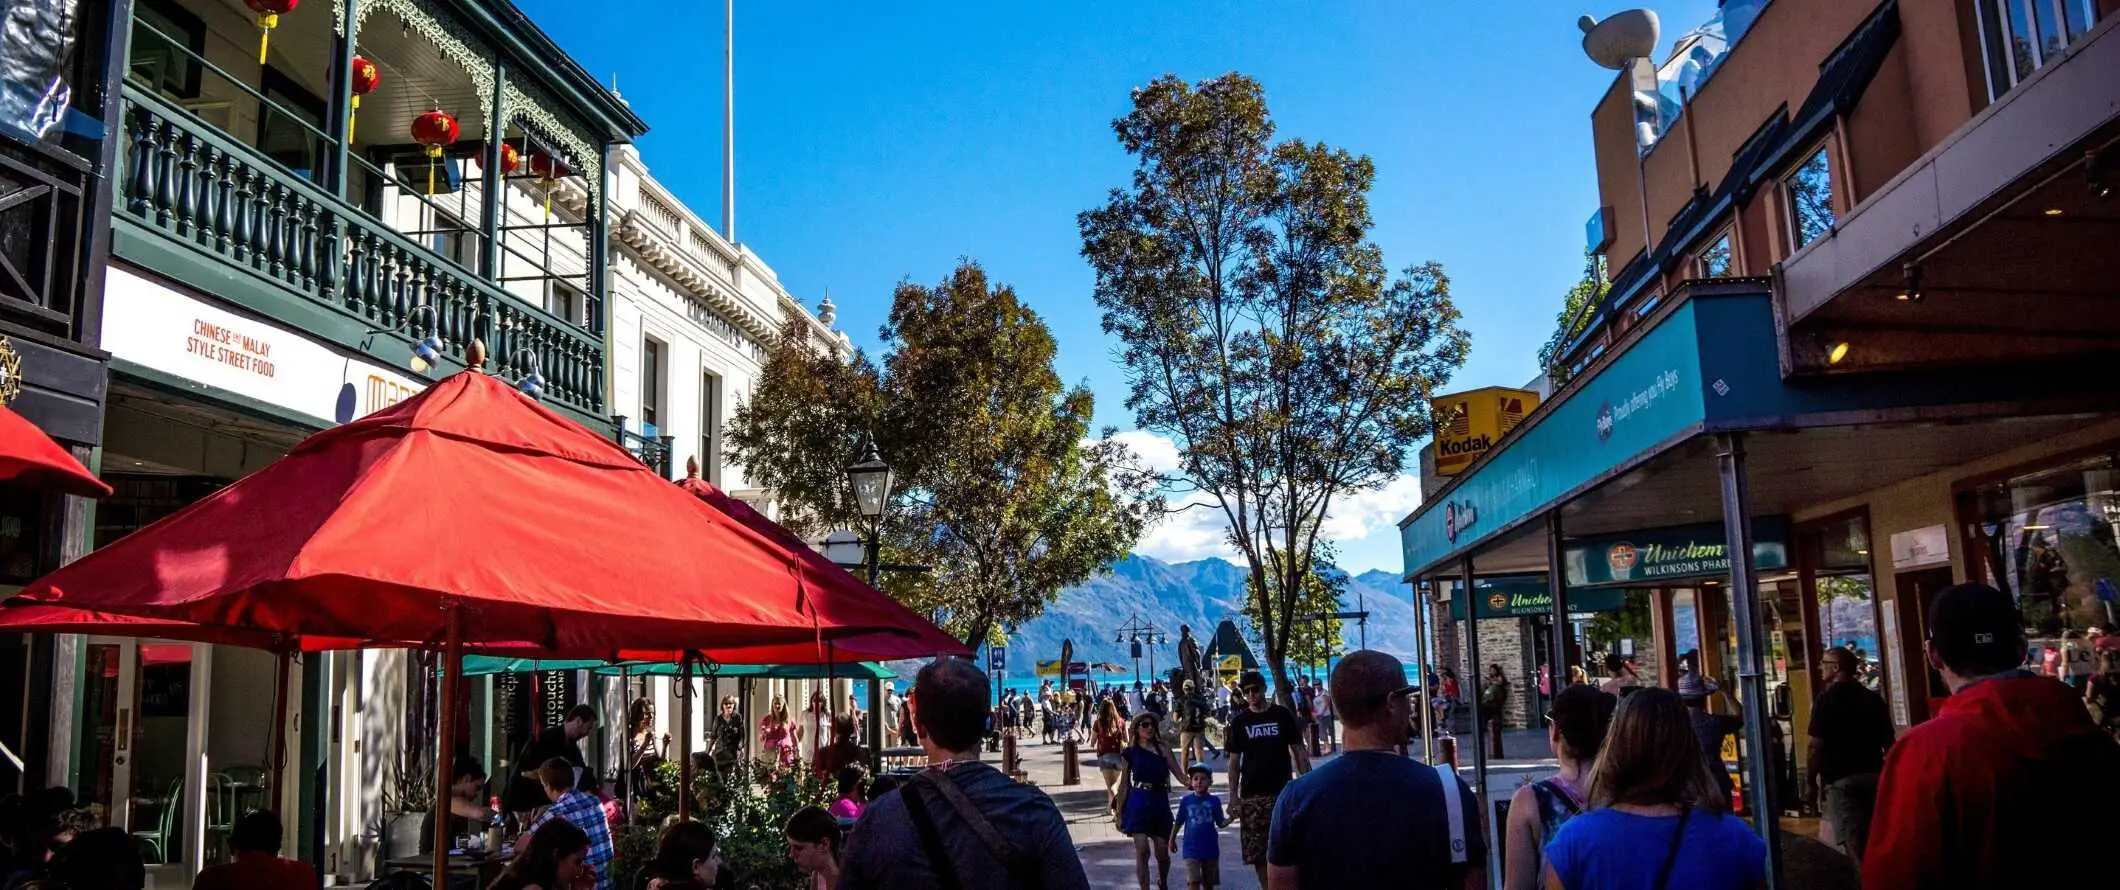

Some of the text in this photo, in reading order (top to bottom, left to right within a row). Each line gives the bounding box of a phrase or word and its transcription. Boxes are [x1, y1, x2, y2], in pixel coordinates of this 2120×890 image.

[194, 318, 231, 345] CHINESE
[242, 335, 271, 358] MALAY
[187, 336, 275, 378] STYLE STREET FOOD
[1441, 433, 1491, 456] Kodak
[1644, 540, 1722, 563] Unichem
[1644, 562, 1699, 576] WILKINSONS
[1511, 592, 1553, 607] Uniche
[557, 671, 565, 711] ZEALAND
[1245, 722, 1279, 738] VANS
